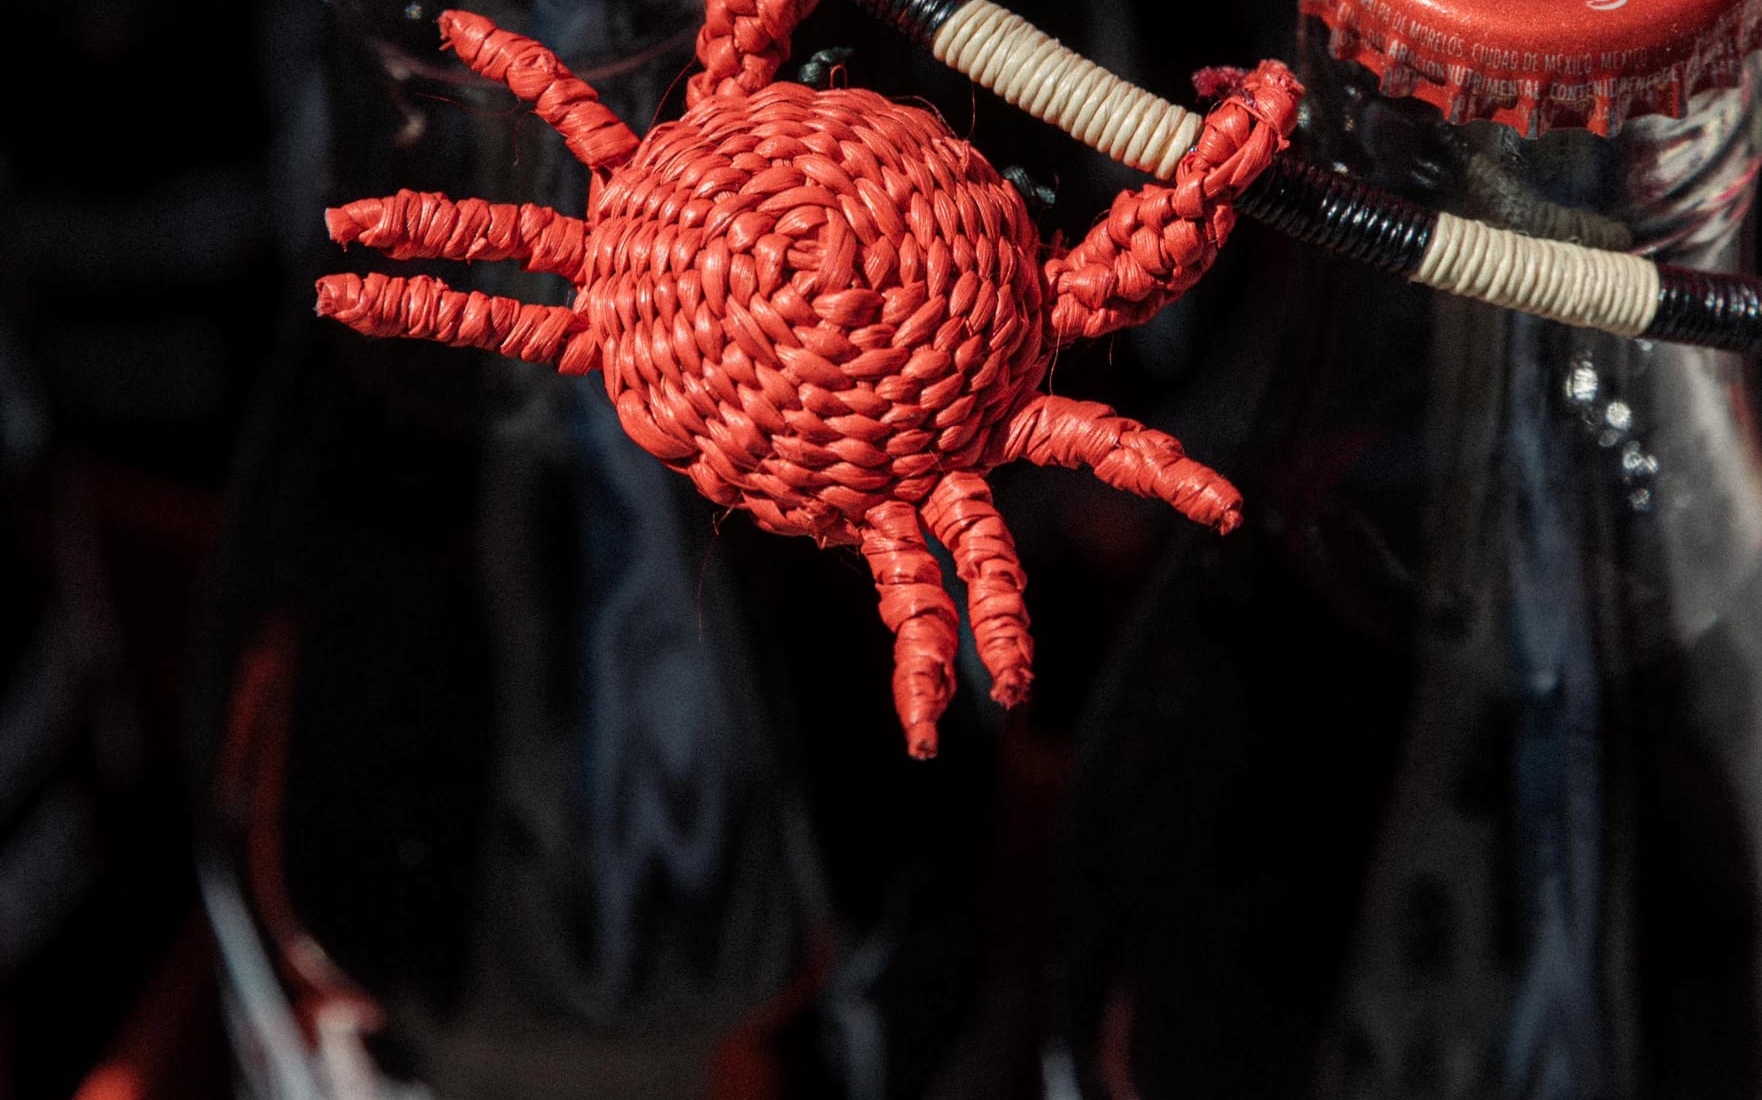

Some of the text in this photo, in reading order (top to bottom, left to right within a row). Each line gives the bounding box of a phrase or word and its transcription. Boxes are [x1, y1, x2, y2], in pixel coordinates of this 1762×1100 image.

[1392, 11, 1408, 35] DE
[1471, 43, 1518, 71] CIUDAD
[1522, 51, 1539, 73] DE
